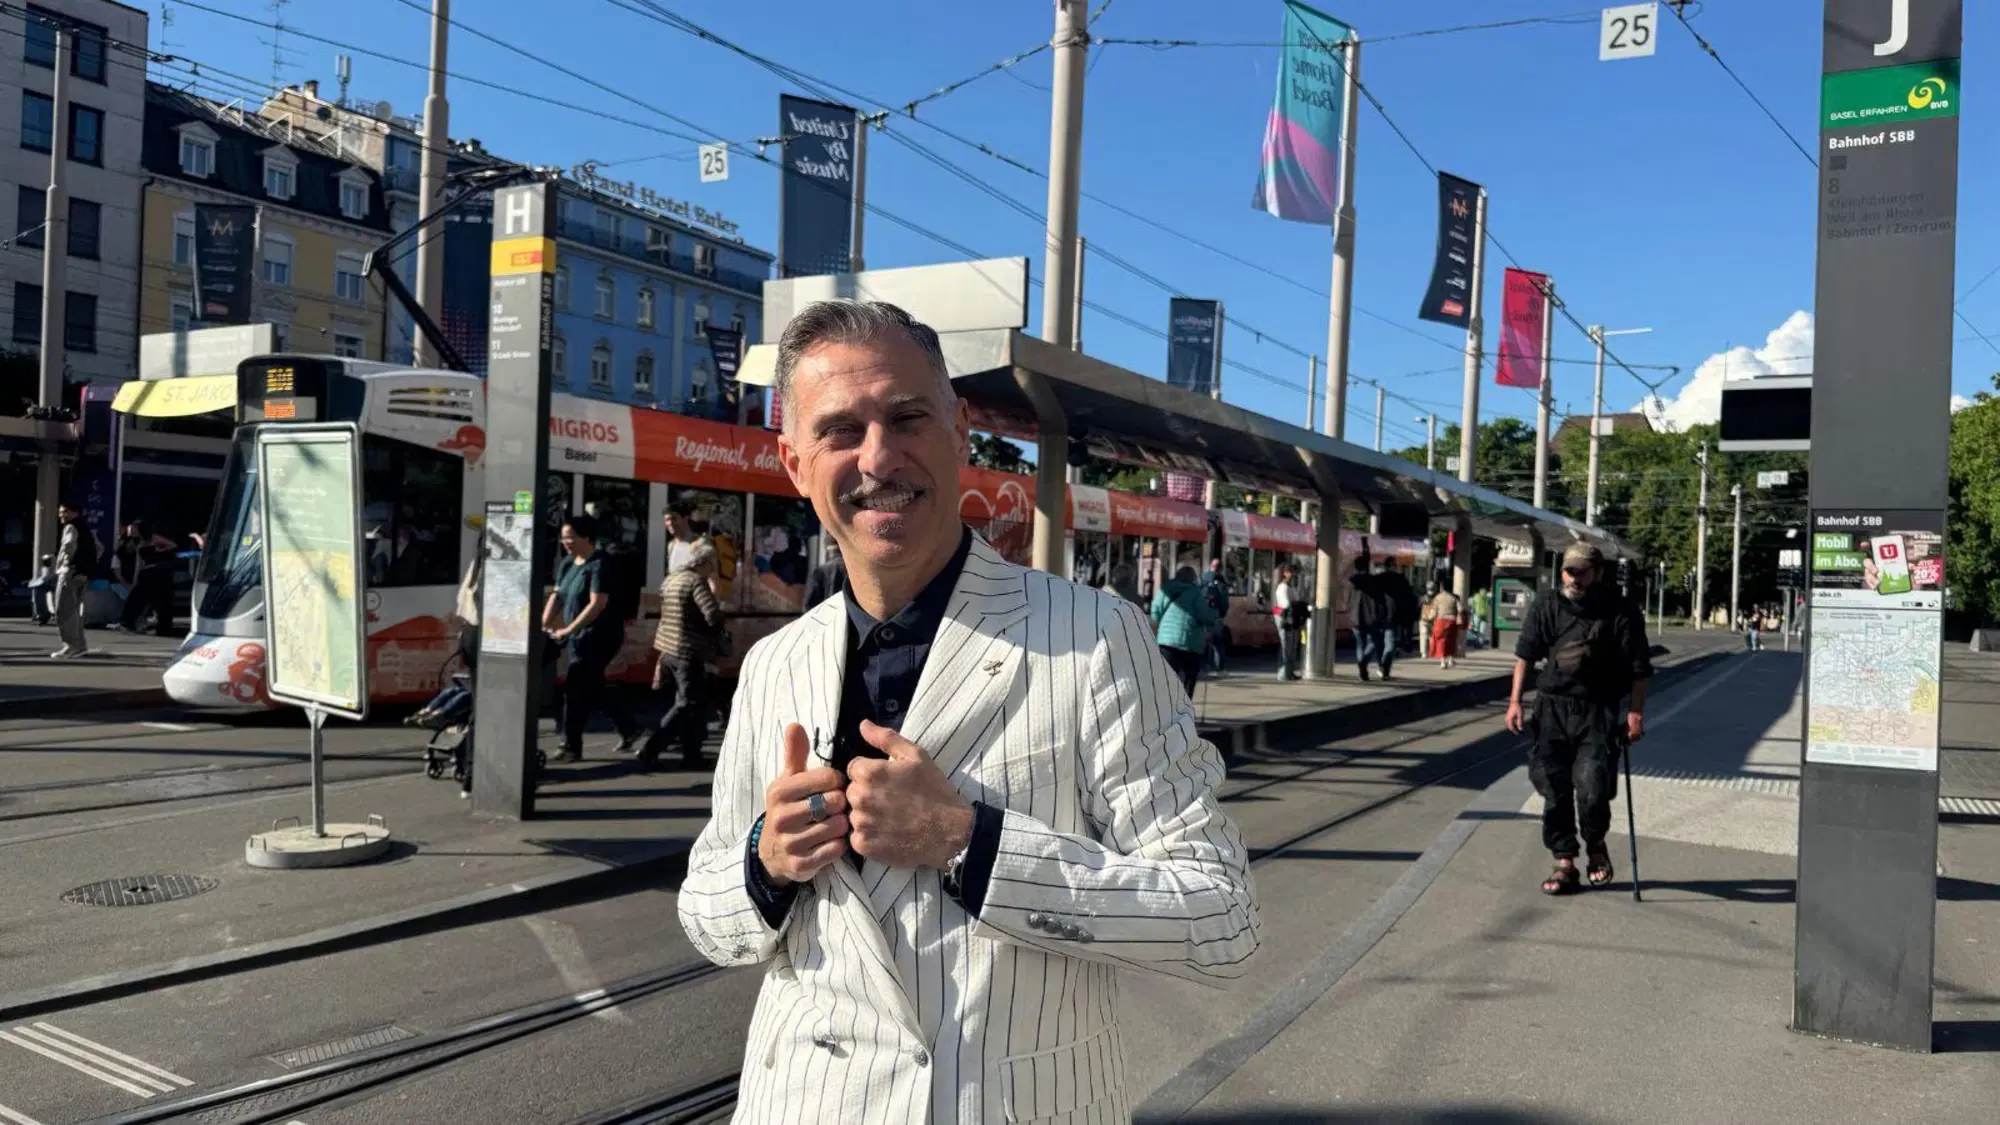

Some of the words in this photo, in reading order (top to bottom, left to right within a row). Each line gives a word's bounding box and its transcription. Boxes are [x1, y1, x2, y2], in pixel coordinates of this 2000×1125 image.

[1609, 14, 1650, 49] 25
[1873, 0, 1910, 57] J
[1830, 110, 1858, 120] BASEL
[1859, 104, 1908, 117] ERFAHREN
[1930, 100, 1949, 110] BVB
[1829, 131, 1885, 149] Bahnhof
[1889, 130, 1915, 143] SBB
[703, 150, 725, 175] 25
[1828, 178, 1840, 195] 8
[641, 186, 690, 217] Hotel
[505, 191, 531, 235] H
[675, 435, 749, 472] Regional,
[1817, 516, 1860, 526] Bahnhof
[1862, 516, 1882, 526] SBB
[1816, 535, 1849, 548] Mobil
[1816, 553, 1831, 567] im
[1834, 554, 1862, 568] Abo.
